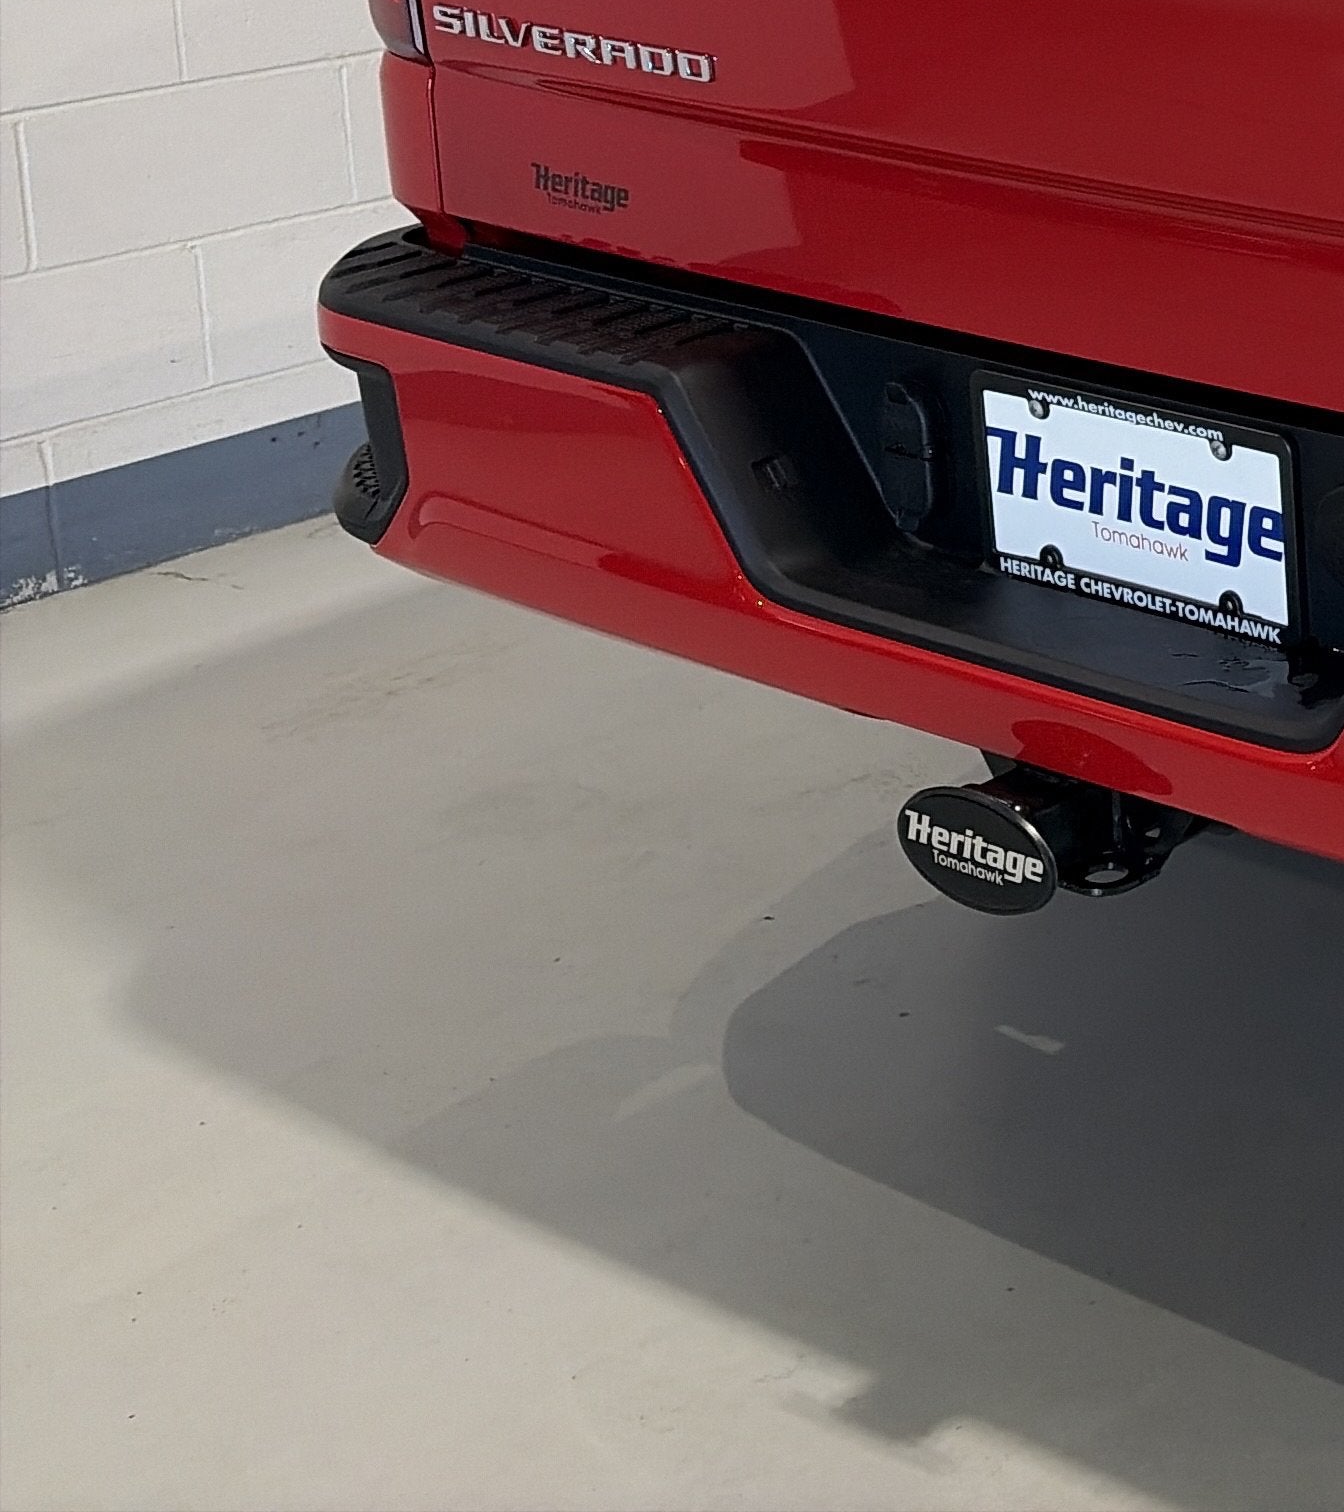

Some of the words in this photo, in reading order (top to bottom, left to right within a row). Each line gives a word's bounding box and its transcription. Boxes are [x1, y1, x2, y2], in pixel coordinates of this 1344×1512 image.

[432, 2, 718, 83] SILVERADO
[530, 161, 630, 213] Heritage
[1027, 388, 1225, 442] www.heritagechev.com
[986, 425, 1285, 569] Heritage
[1091, 520, 1189, 563] Tomahawk
[1000, 556, 1076, 590] HERITAGE
[1079, 576, 1281, 645] CHEVROLET-TOMAHAWK
[904, 809, 1044, 885] Heritage
[931, 848, 1005, 886] Tomahawk
